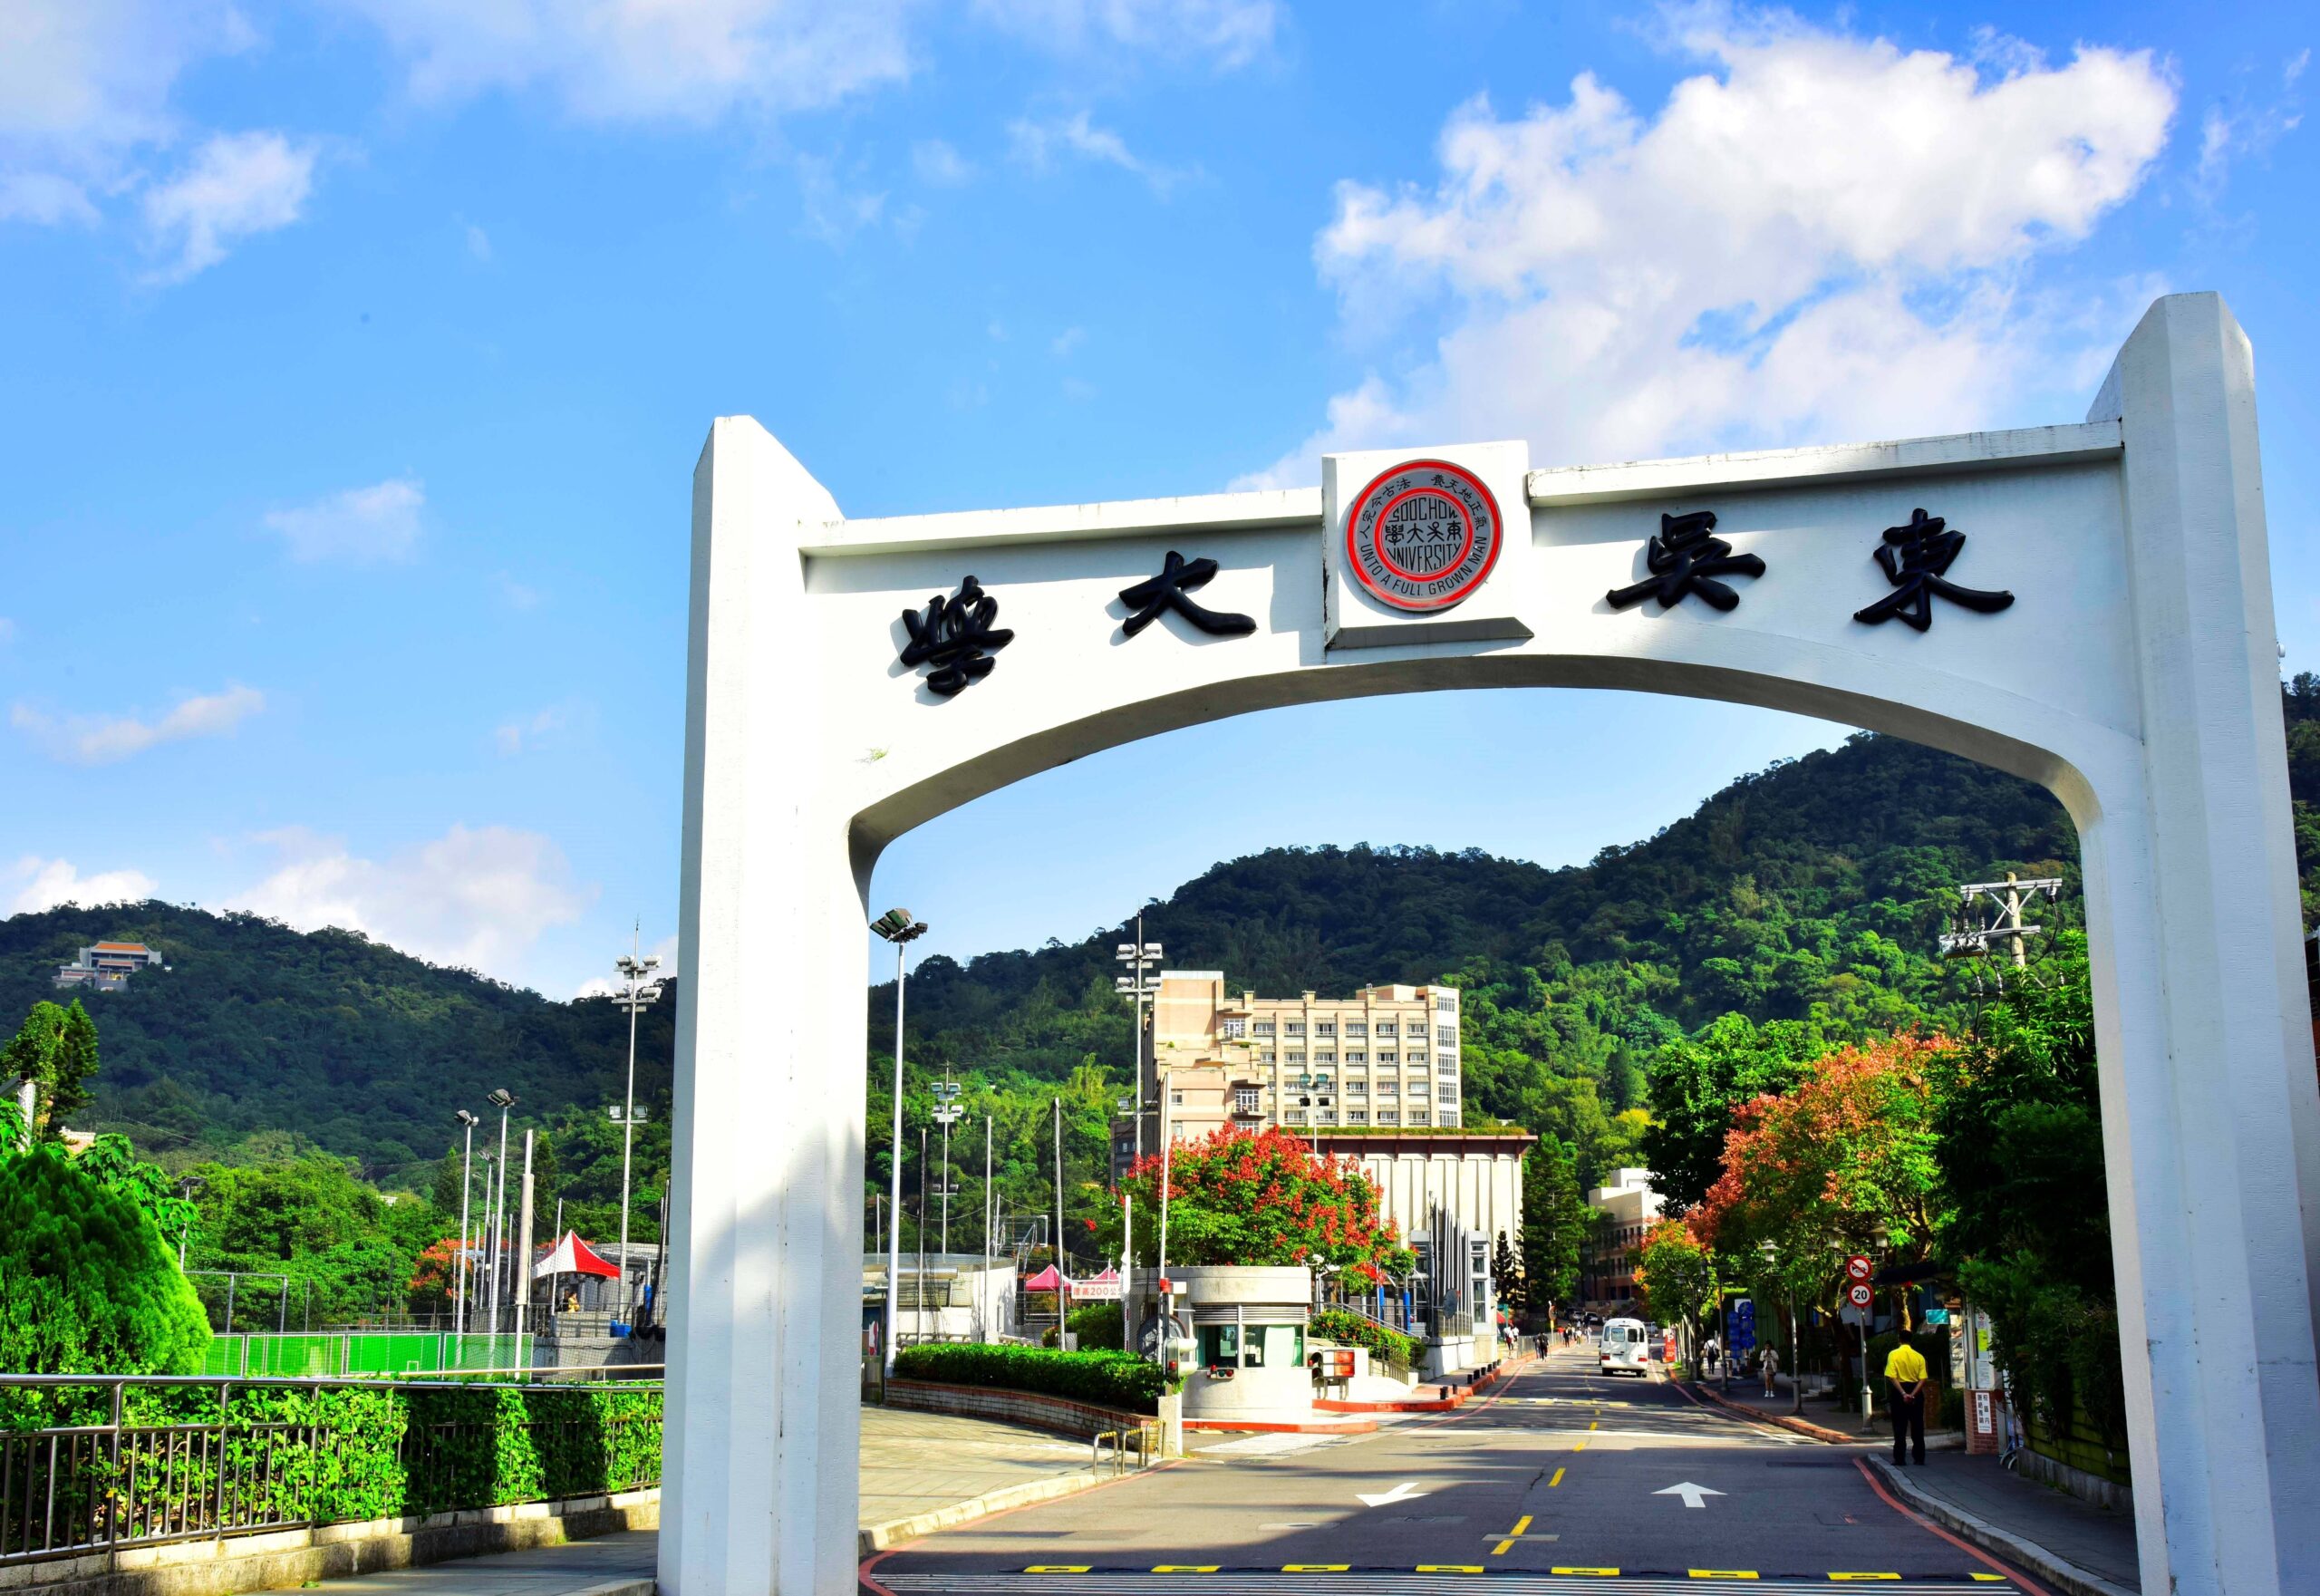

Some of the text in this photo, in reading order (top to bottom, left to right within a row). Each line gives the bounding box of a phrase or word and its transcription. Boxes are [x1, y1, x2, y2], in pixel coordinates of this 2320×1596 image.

[1388, 497, 1458, 523] SOOCHOW
[1360, 544, 1383, 576] UNTO
[1380, 574, 1391, 585] A
[1428, 566, 1473, 595] GROWN
[1468, 536, 1487, 565] MAN
[1387, 542, 1462, 573] UNIVERSITY
[1854, 1290, 1867, 1300] 20
